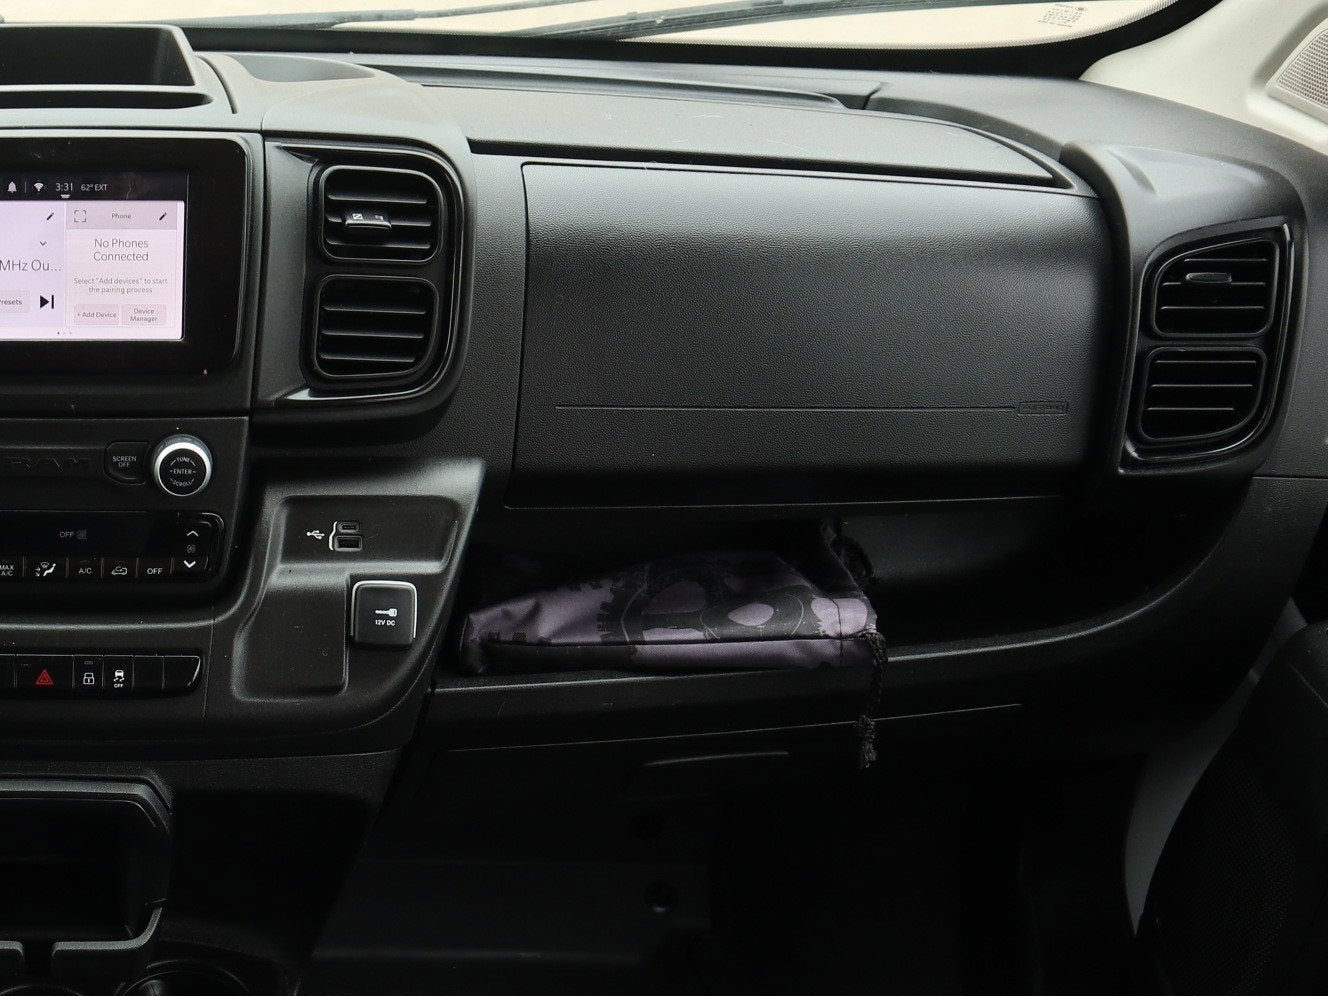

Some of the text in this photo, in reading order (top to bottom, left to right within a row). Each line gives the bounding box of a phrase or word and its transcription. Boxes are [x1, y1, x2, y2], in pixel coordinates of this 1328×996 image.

[55, 182, 73, 191] 3:31
[112, 212, 132, 220] Phone
[94, 238, 149, 248] No Phones
[93, 251, 149, 262] Connected
[0, 259, 28, 272] MHz
[73, 277, 95, 285] Select
[96, 277, 113, 285] "Add
[114, 277, 143, 285] devices"
[101, 286, 125, 294] pairing
